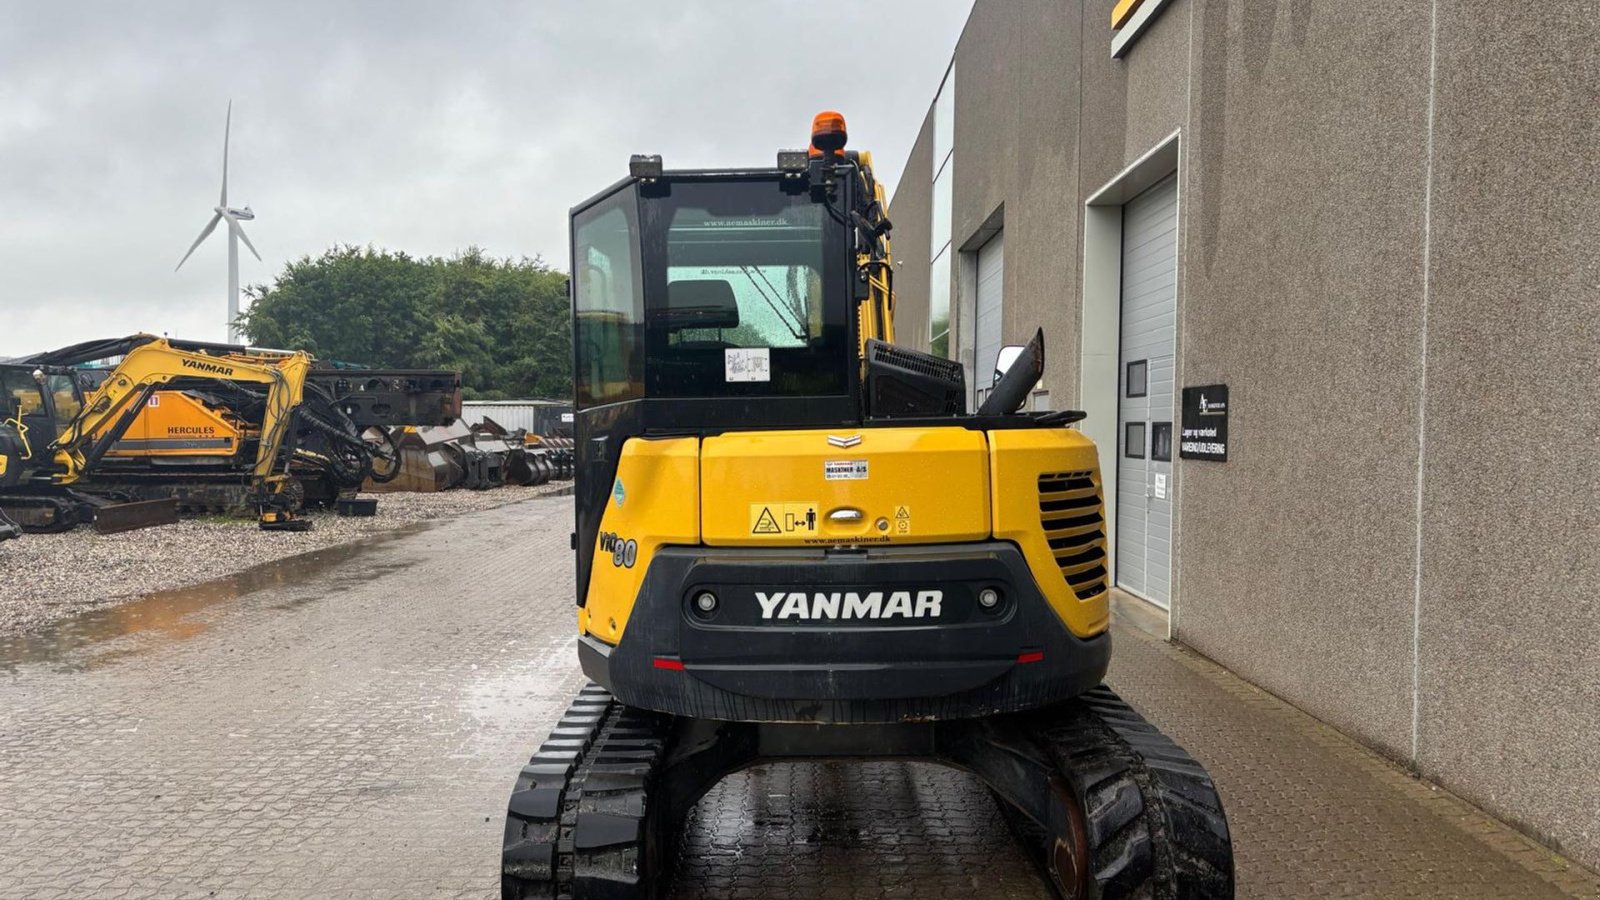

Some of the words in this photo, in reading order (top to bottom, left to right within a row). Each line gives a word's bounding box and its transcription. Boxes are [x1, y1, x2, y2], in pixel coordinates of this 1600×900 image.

[182, 359, 234, 376] YANMAR
[168, 426, 215, 434] HERCULES
[804, 535, 891, 545] www.aemaskiner.dk
[754, 590, 943, 620] YANMAR
